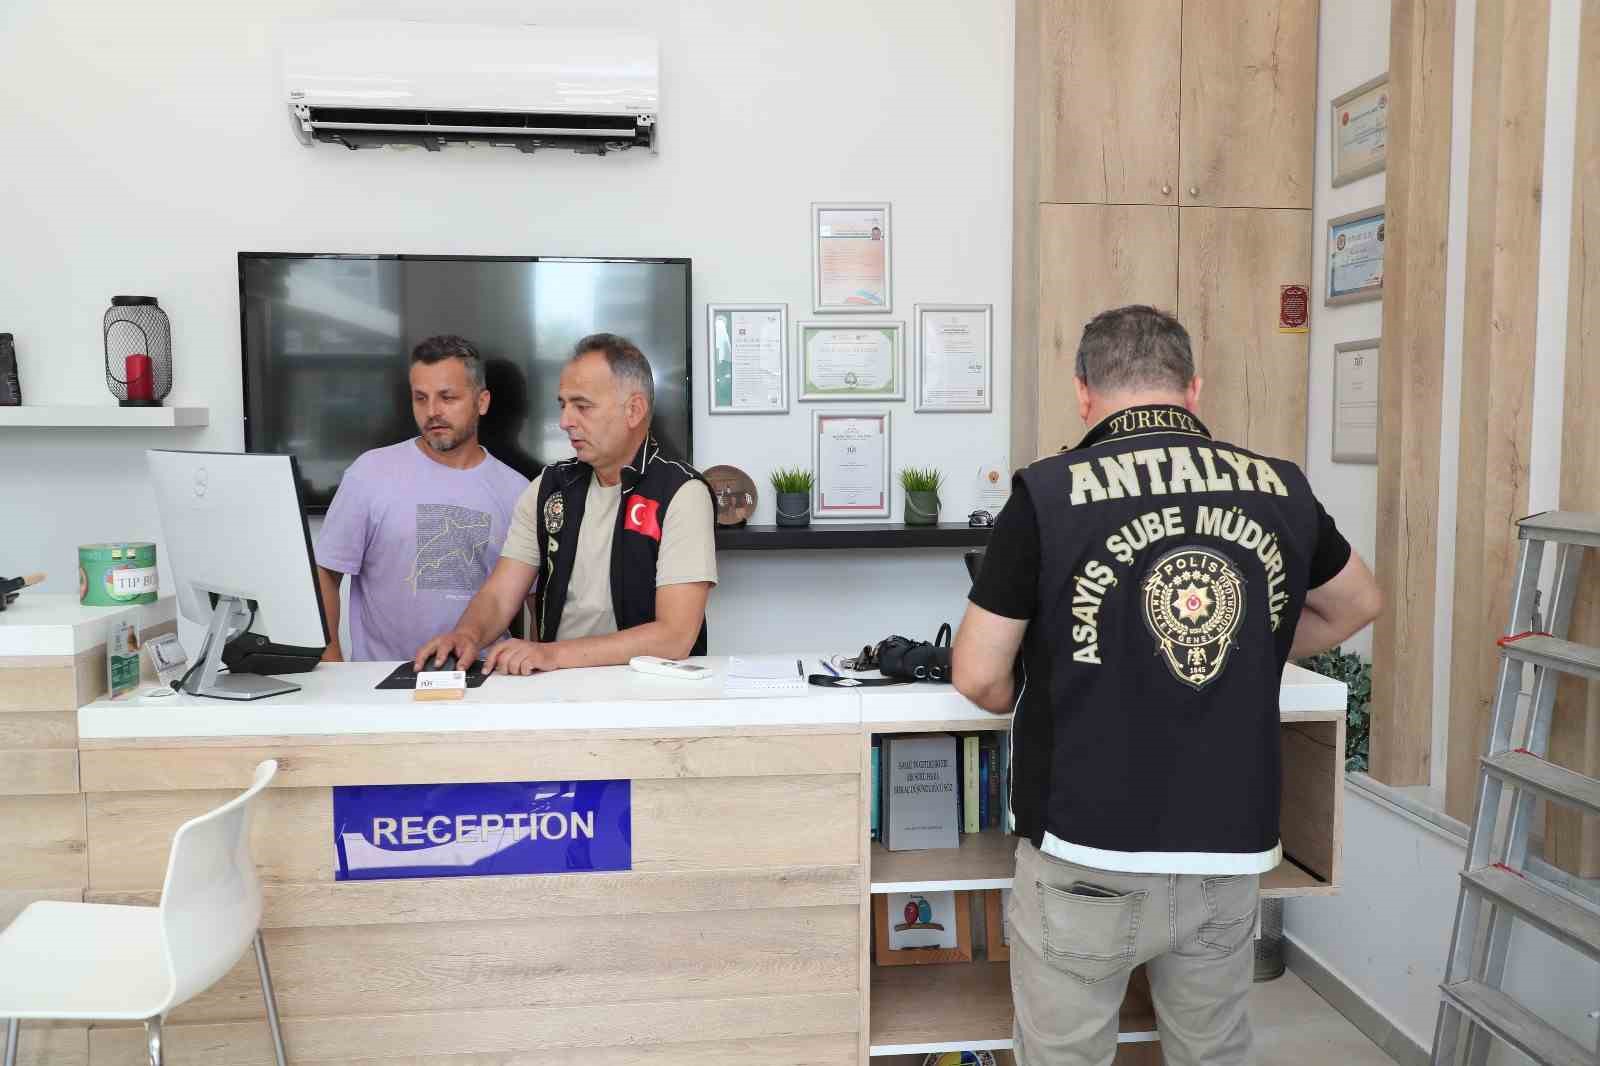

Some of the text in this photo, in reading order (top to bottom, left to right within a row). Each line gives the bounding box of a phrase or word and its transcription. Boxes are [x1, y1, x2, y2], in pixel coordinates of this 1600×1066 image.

[1069, 447, 1288, 505] ANTALYA
[1072, 561, 1118, 665] ASAYİŞ
[1106, 506, 1185, 566] ŞUBE
[1163, 556, 1218, 575] POLİS
[373, 811, 594, 846] RECEPTION
